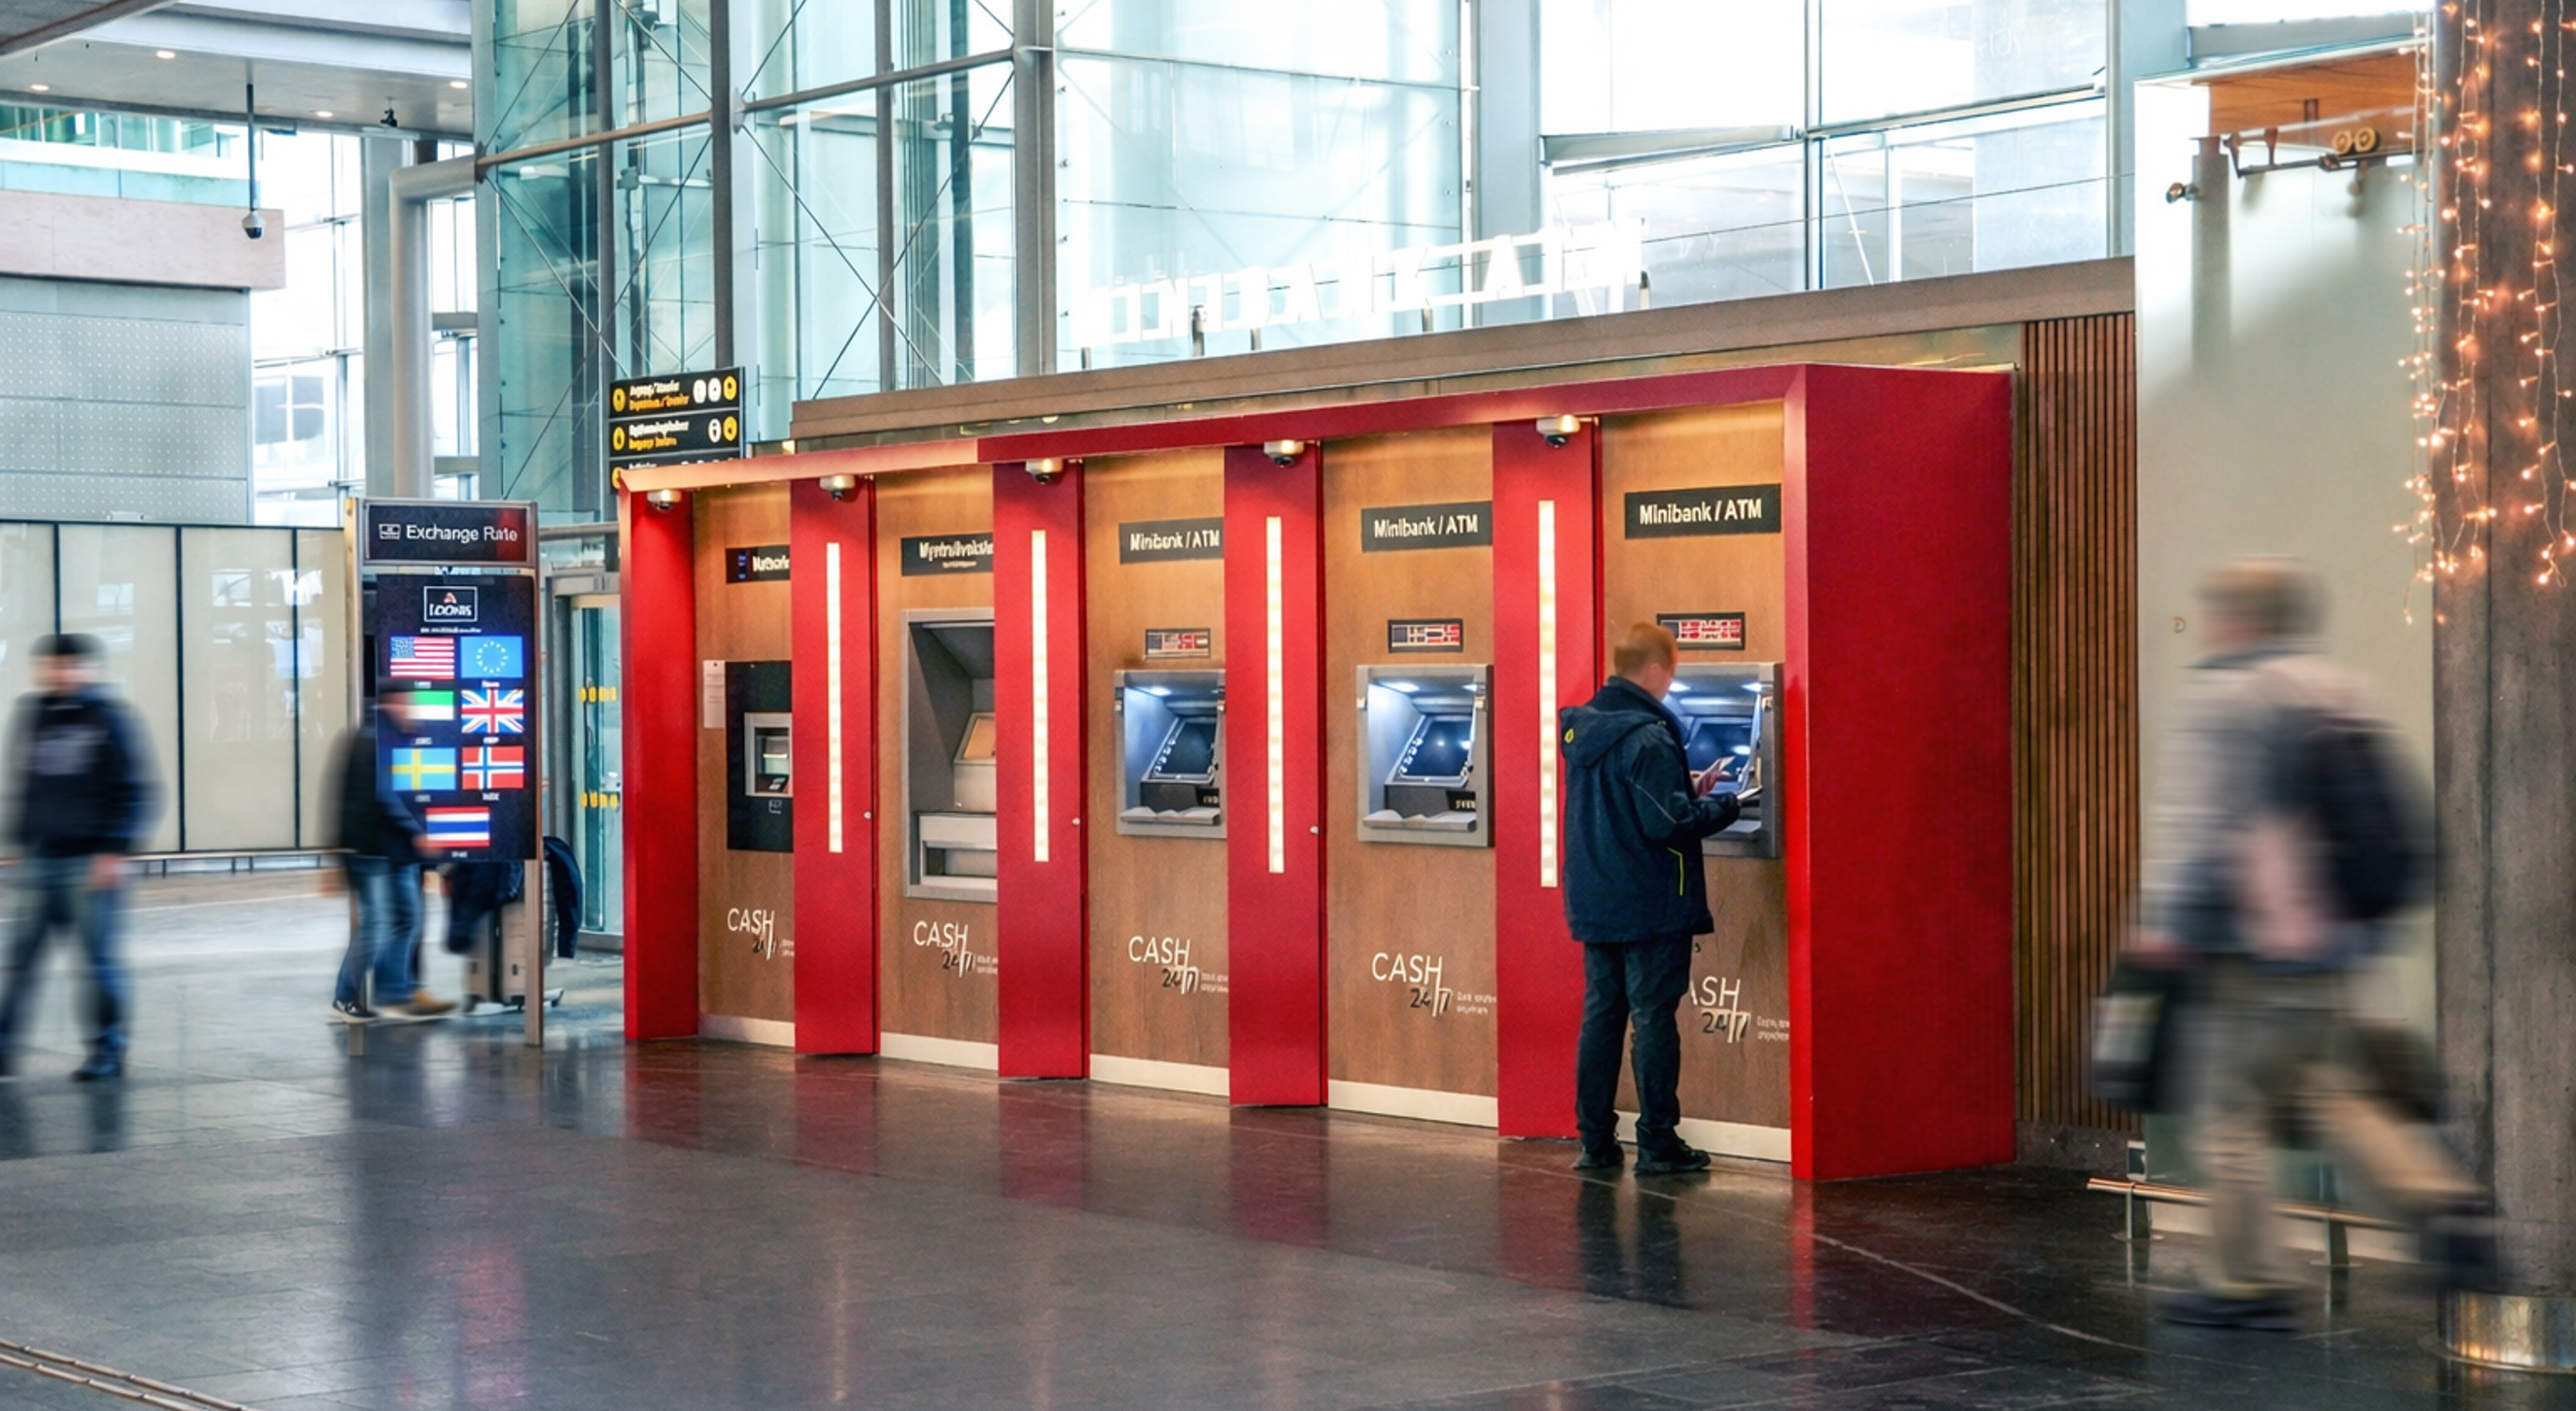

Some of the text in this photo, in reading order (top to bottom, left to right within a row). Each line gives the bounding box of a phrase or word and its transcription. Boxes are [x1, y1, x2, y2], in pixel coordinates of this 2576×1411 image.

[1374, 517, 1436, 538] Minibank
[1446, 514, 1478, 535] ATM
[1639, 501, 1712, 524] Minibank
[1724, 499, 1762, 521] ATM
[406, 523, 518, 544] Exchange Rate
[1193, 529, 1220, 549] ATM
[727, 907, 775, 946] CASH
[914, 920, 969, 962] CASH
[1128, 935, 1191, 977] CASH
[1371, 952, 1443, 999] CASH
